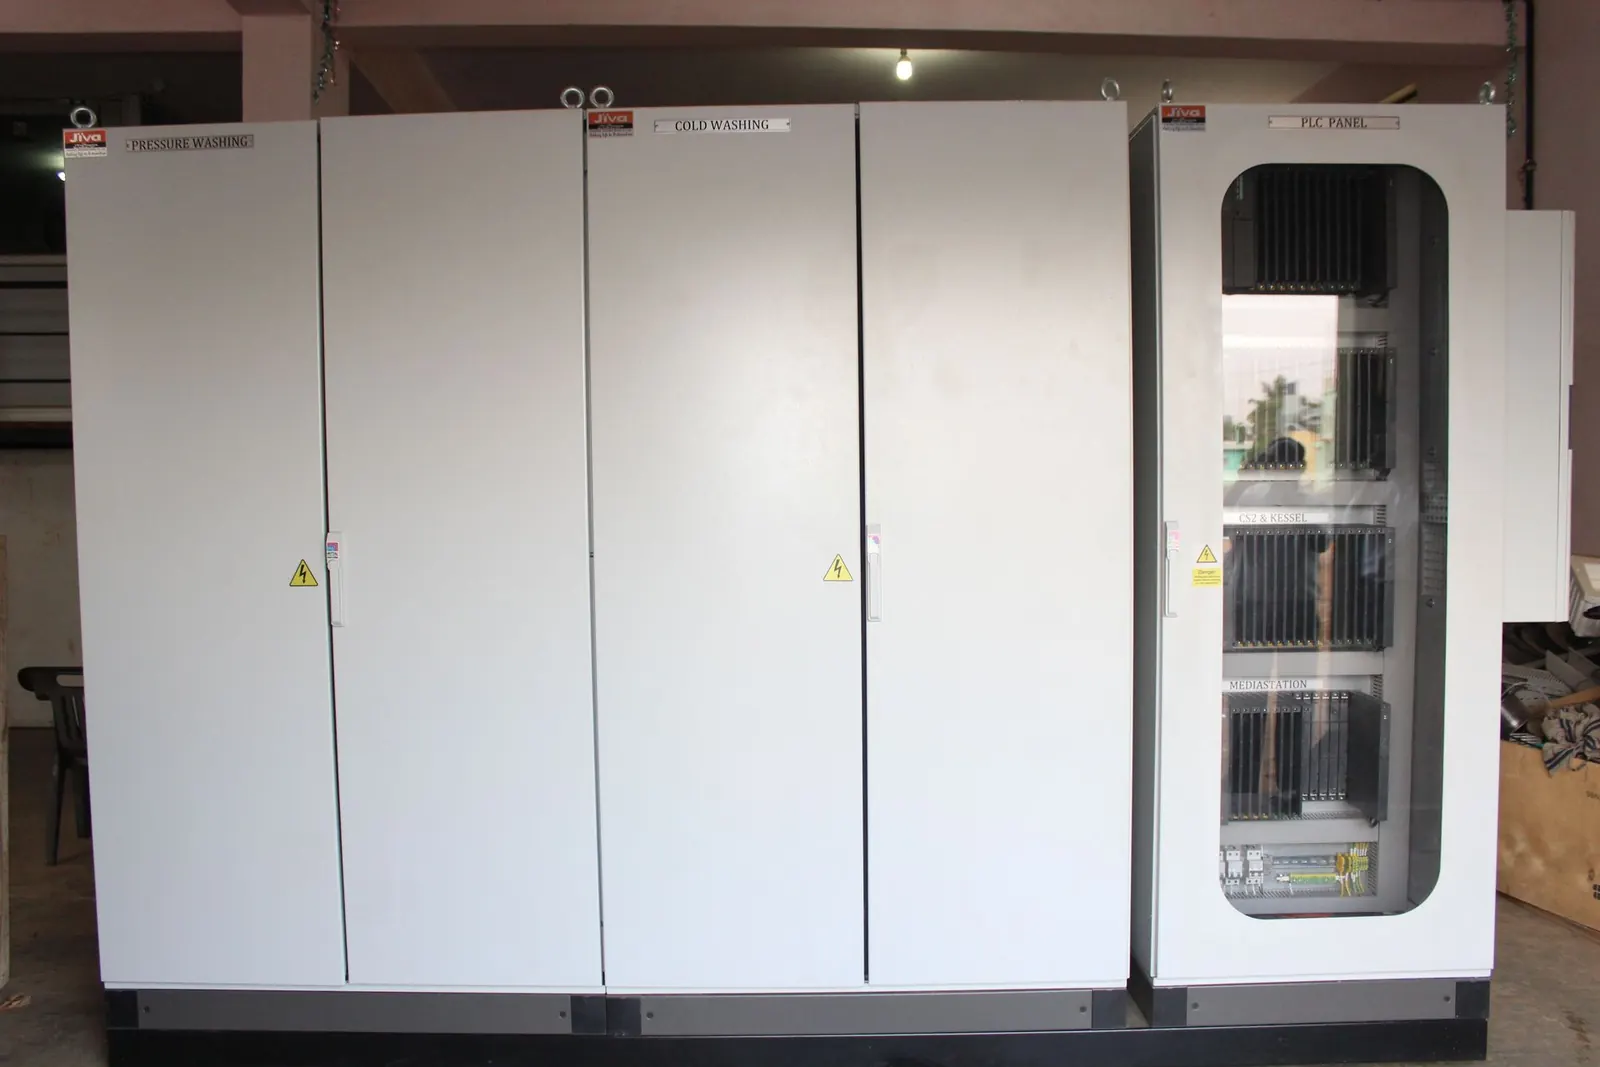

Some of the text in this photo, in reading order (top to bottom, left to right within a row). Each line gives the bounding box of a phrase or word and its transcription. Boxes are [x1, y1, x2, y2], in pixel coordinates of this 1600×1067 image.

[675, 119, 769, 132] COLD WASHING
[1301, 116, 1368, 128] PLC PANEL
[131, 135, 249, 151] PRESSURE WASHING
[1239, 512, 1308, 523] CS2 & KESSEL
[1229, 680, 1308, 691] MEDIASTATION
